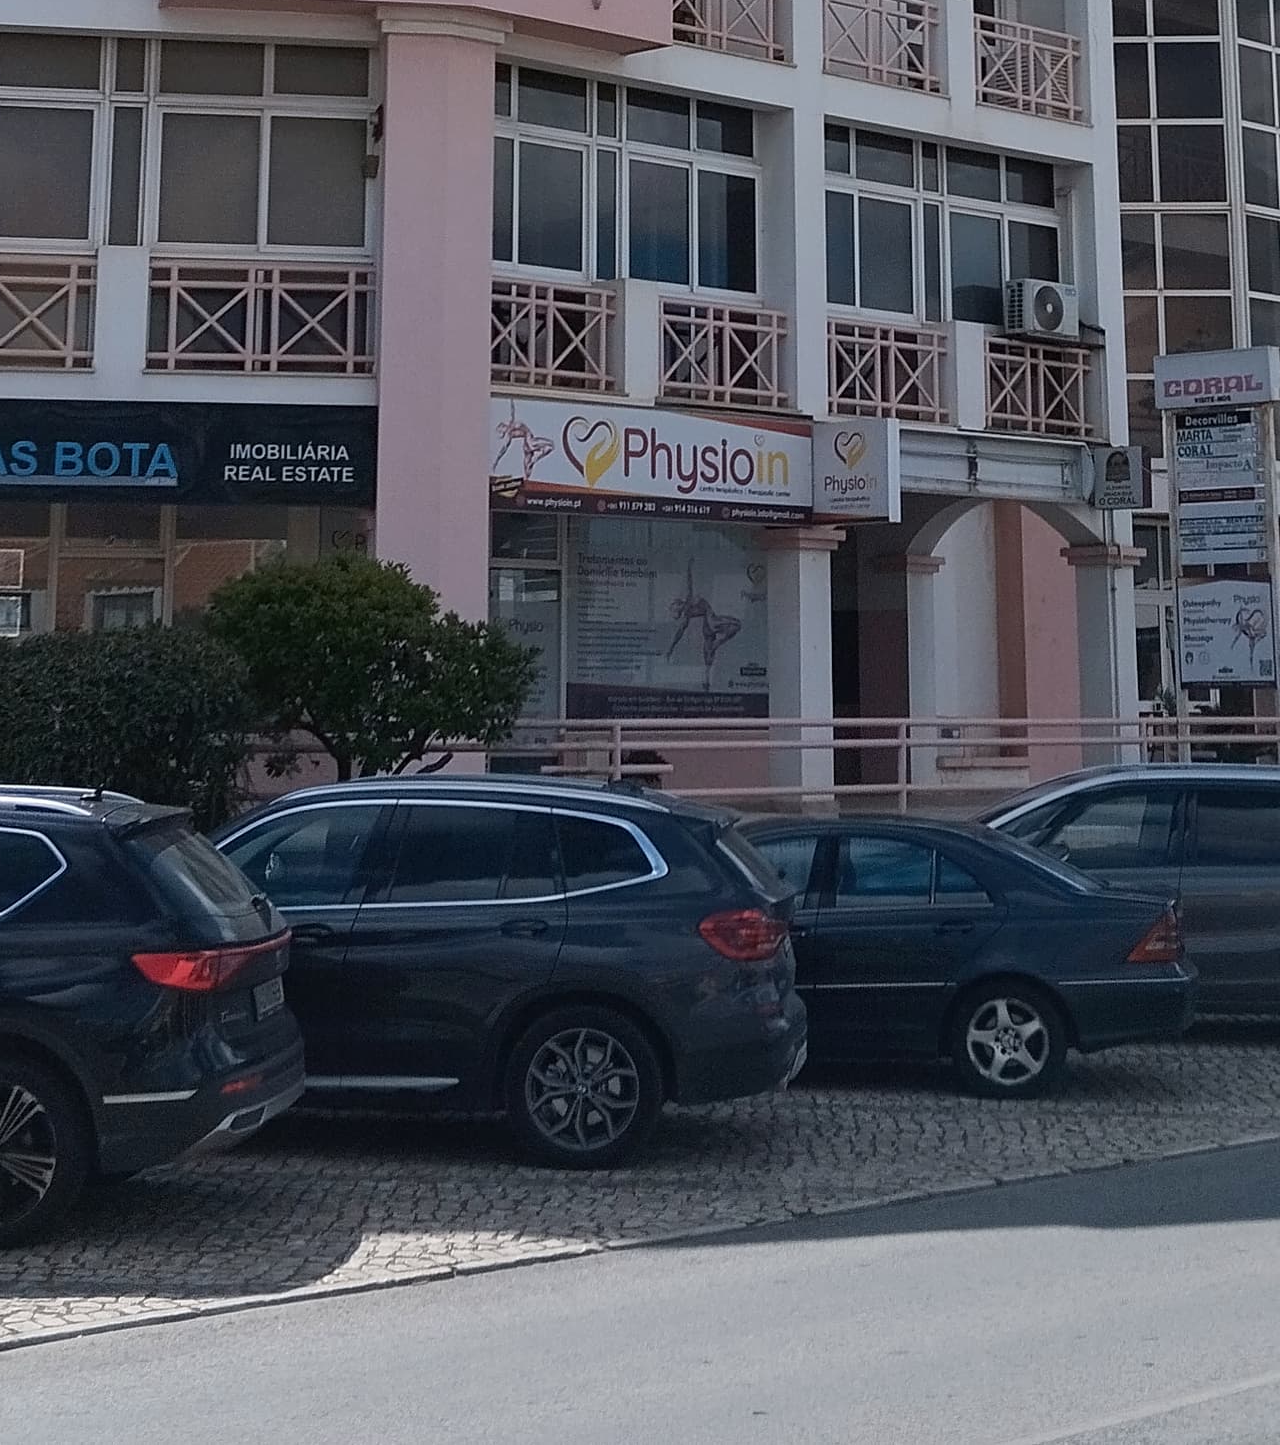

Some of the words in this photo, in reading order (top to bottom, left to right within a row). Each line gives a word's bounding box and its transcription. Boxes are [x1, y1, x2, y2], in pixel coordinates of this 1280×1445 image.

[1164, 374, 1263, 397] CORAL
[1185, 414, 1238, 427] Decorvillas
[1177, 429, 1213, 443] MARTA
[230, 441, 350, 460] IMOBILIÁRIA
[1178, 445, 1213, 457] CORAL
[55, 441, 178, 478] BOTA
[623, 428, 789, 493] Physioin
[224, 465, 276, 481] REAL
[282, 466, 354, 482] ESTATE
[1107, 497, 1138, 505] CORAL
